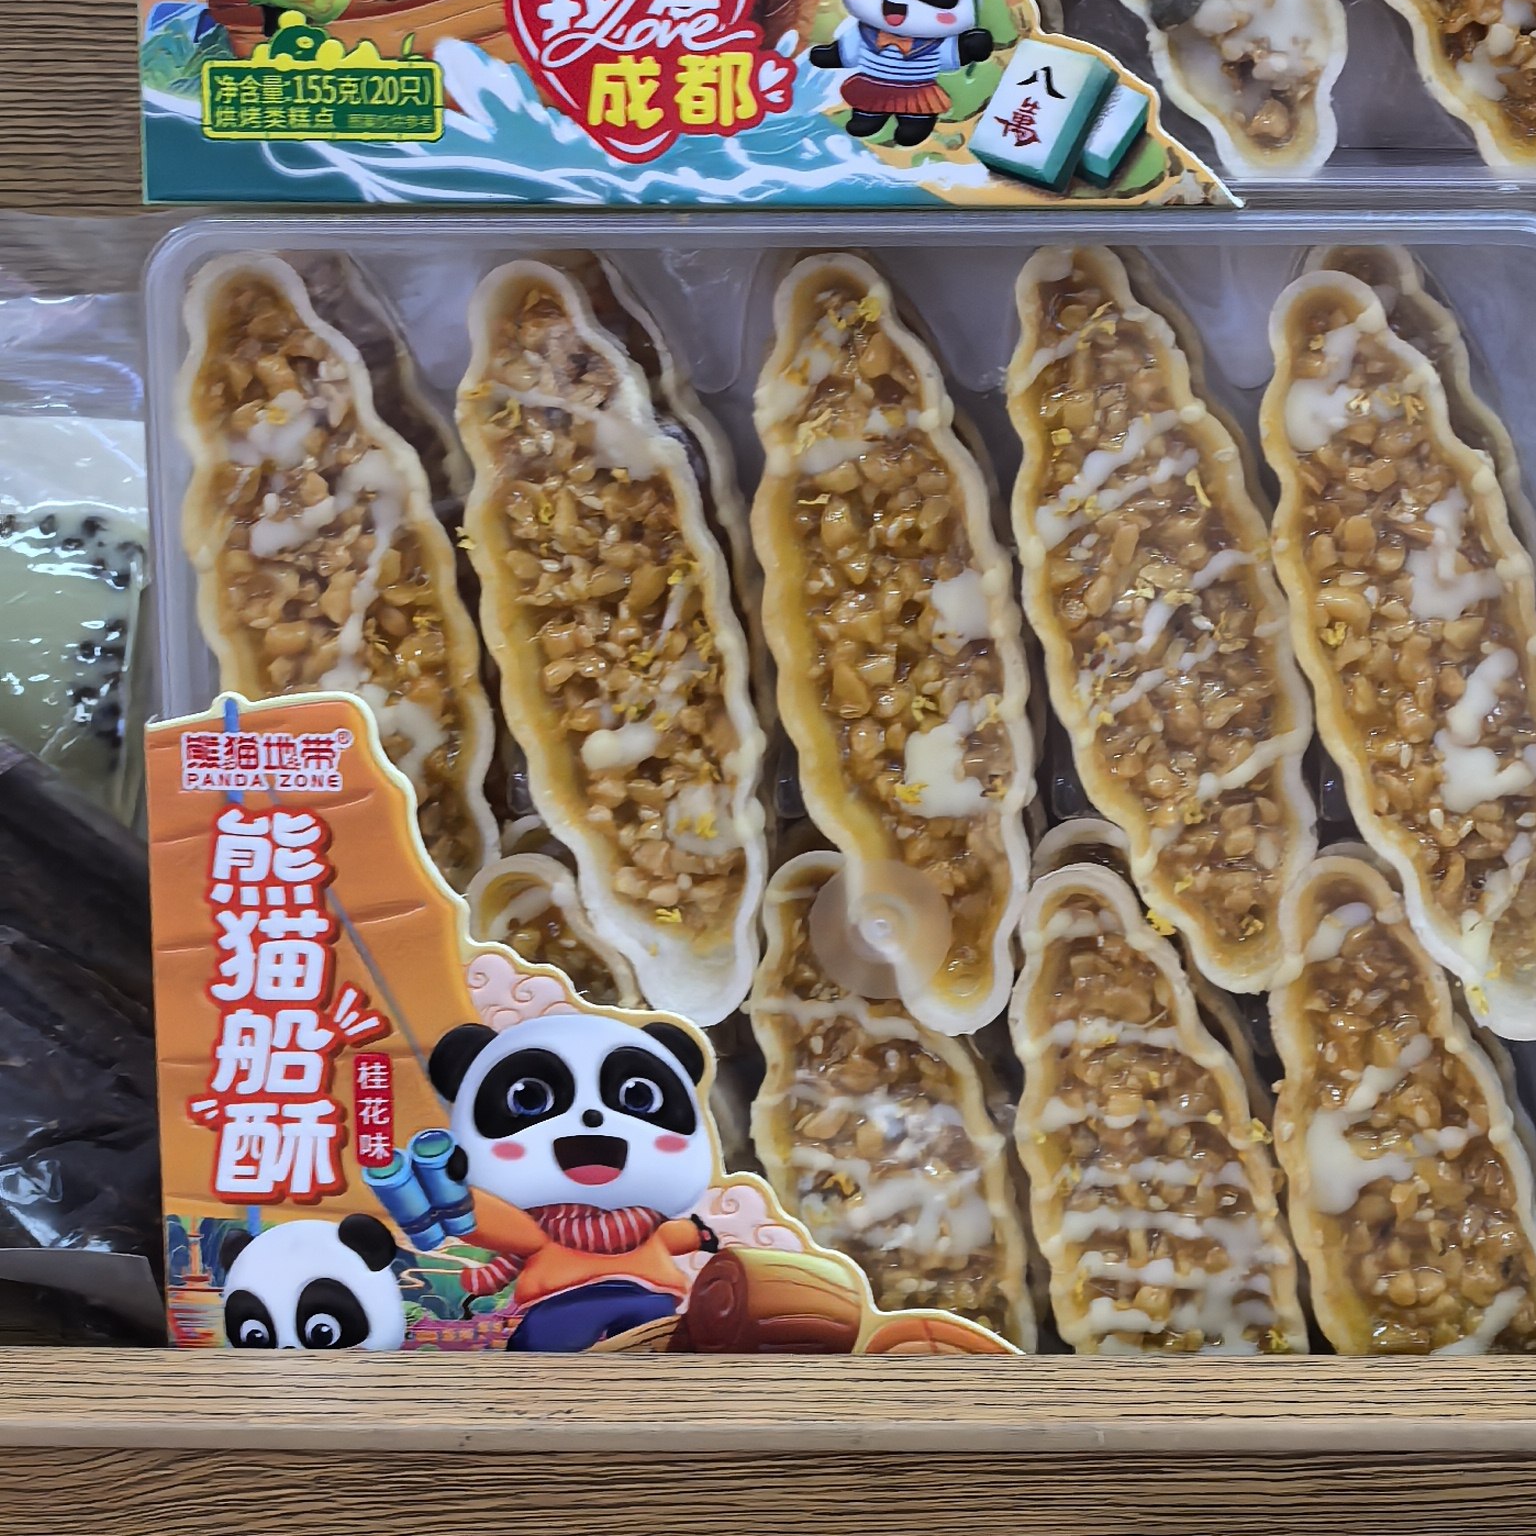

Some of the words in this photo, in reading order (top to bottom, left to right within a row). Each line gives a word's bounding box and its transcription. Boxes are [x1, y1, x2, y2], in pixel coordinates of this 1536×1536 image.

[586, 51, 759, 130] 成都
[187, 773, 266, 788] PANDA
[279, 774, 341, 789] ZONE
[209, 807, 338, 1195] 熊猫船酥
[356, 1061, 392, 1160] 桂花味
